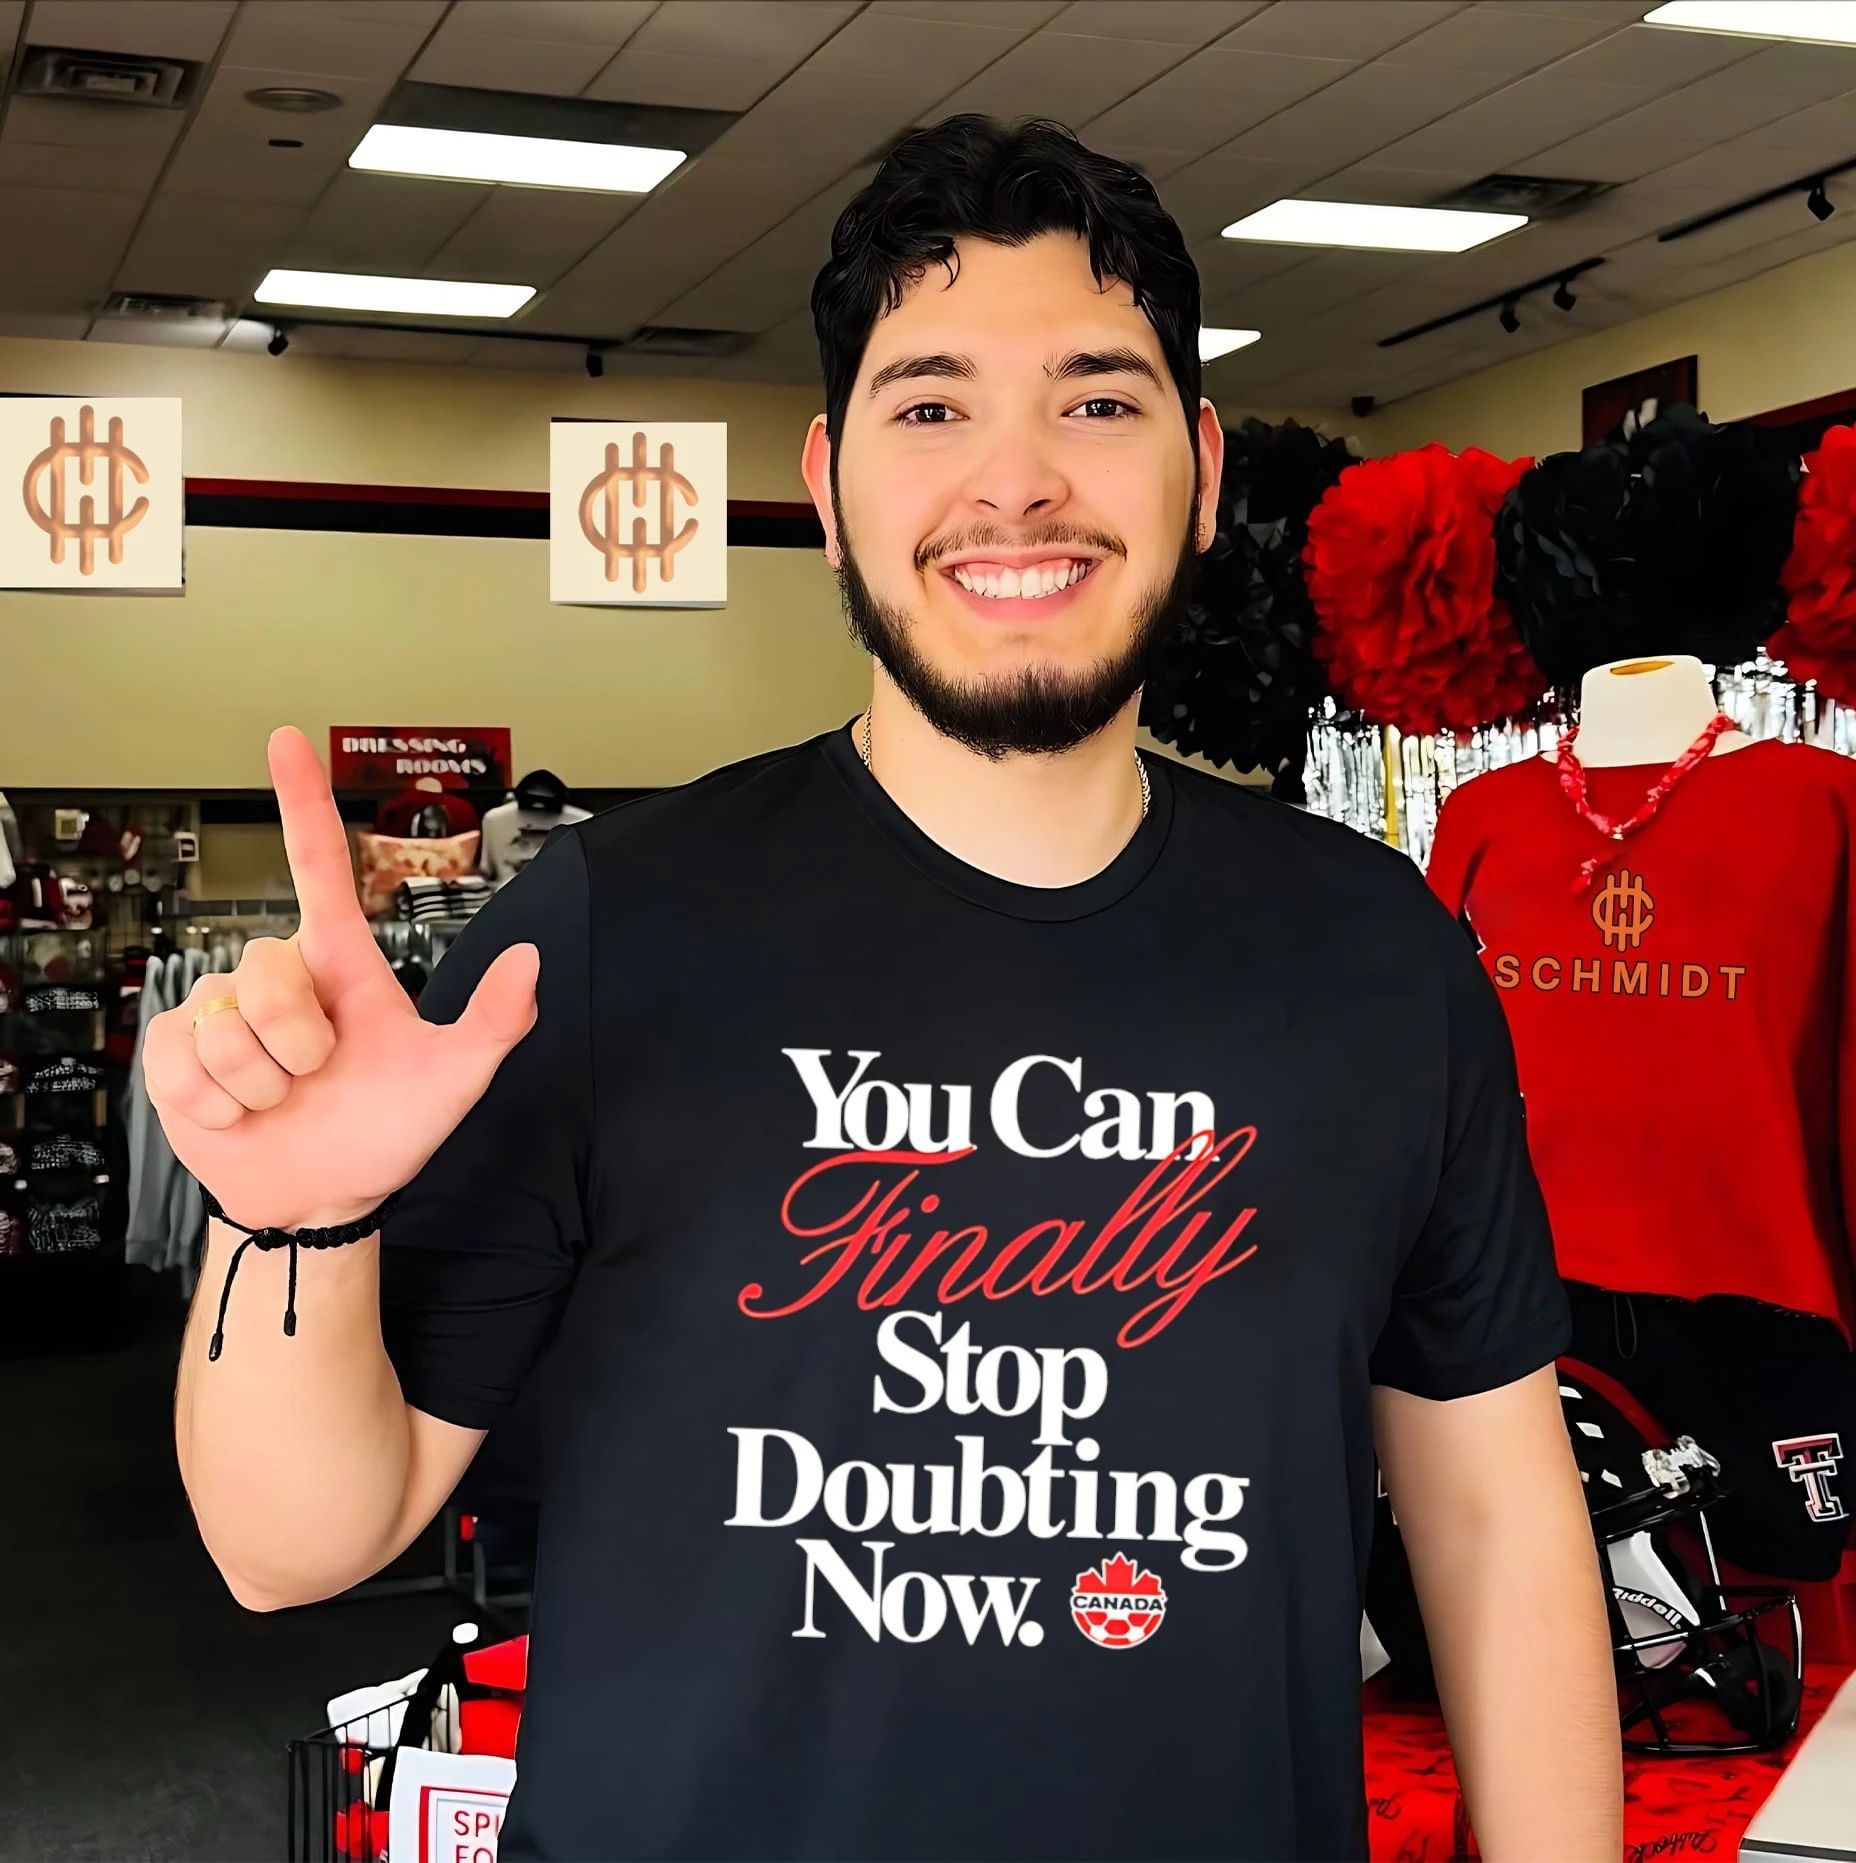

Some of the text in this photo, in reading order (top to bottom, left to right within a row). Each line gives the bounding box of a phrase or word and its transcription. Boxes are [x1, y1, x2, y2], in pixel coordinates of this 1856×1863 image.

[342, 737, 467, 754] DRESSING
[396, 758, 487, 775] ROOMS
[1494, 954, 1747, 1001] SCHMIDT
[781, 1047, 1220, 1162] You Can
[737, 1125, 1258, 1348] Finally
[873, 1310, 1108, 1445] Stop
[724, 1427, 1249, 1572] Doubting
[792, 1537, 1044, 1647] Now.
[1072, 1595, 1164, 1612] CANADA
